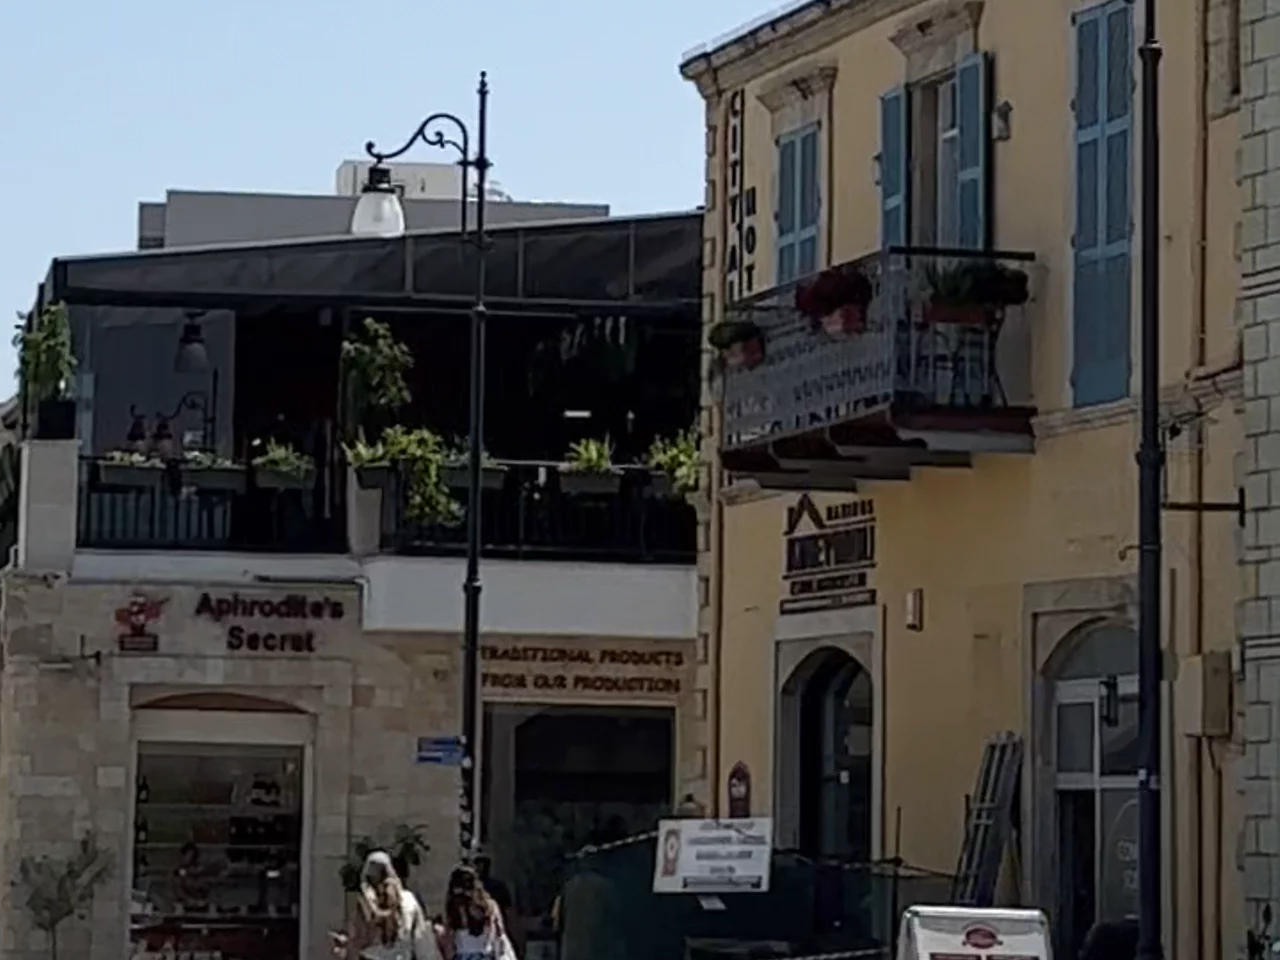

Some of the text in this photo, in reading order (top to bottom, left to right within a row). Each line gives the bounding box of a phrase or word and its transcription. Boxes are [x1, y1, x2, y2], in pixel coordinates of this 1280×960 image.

[195, 592, 345, 622] Aphrodite's
[226, 625, 317, 653] Secret
[480, 645, 685, 667] TRADITIONAL PRODUCTS
[480, 672, 682, 694] FROM OUR PRODUCTION
